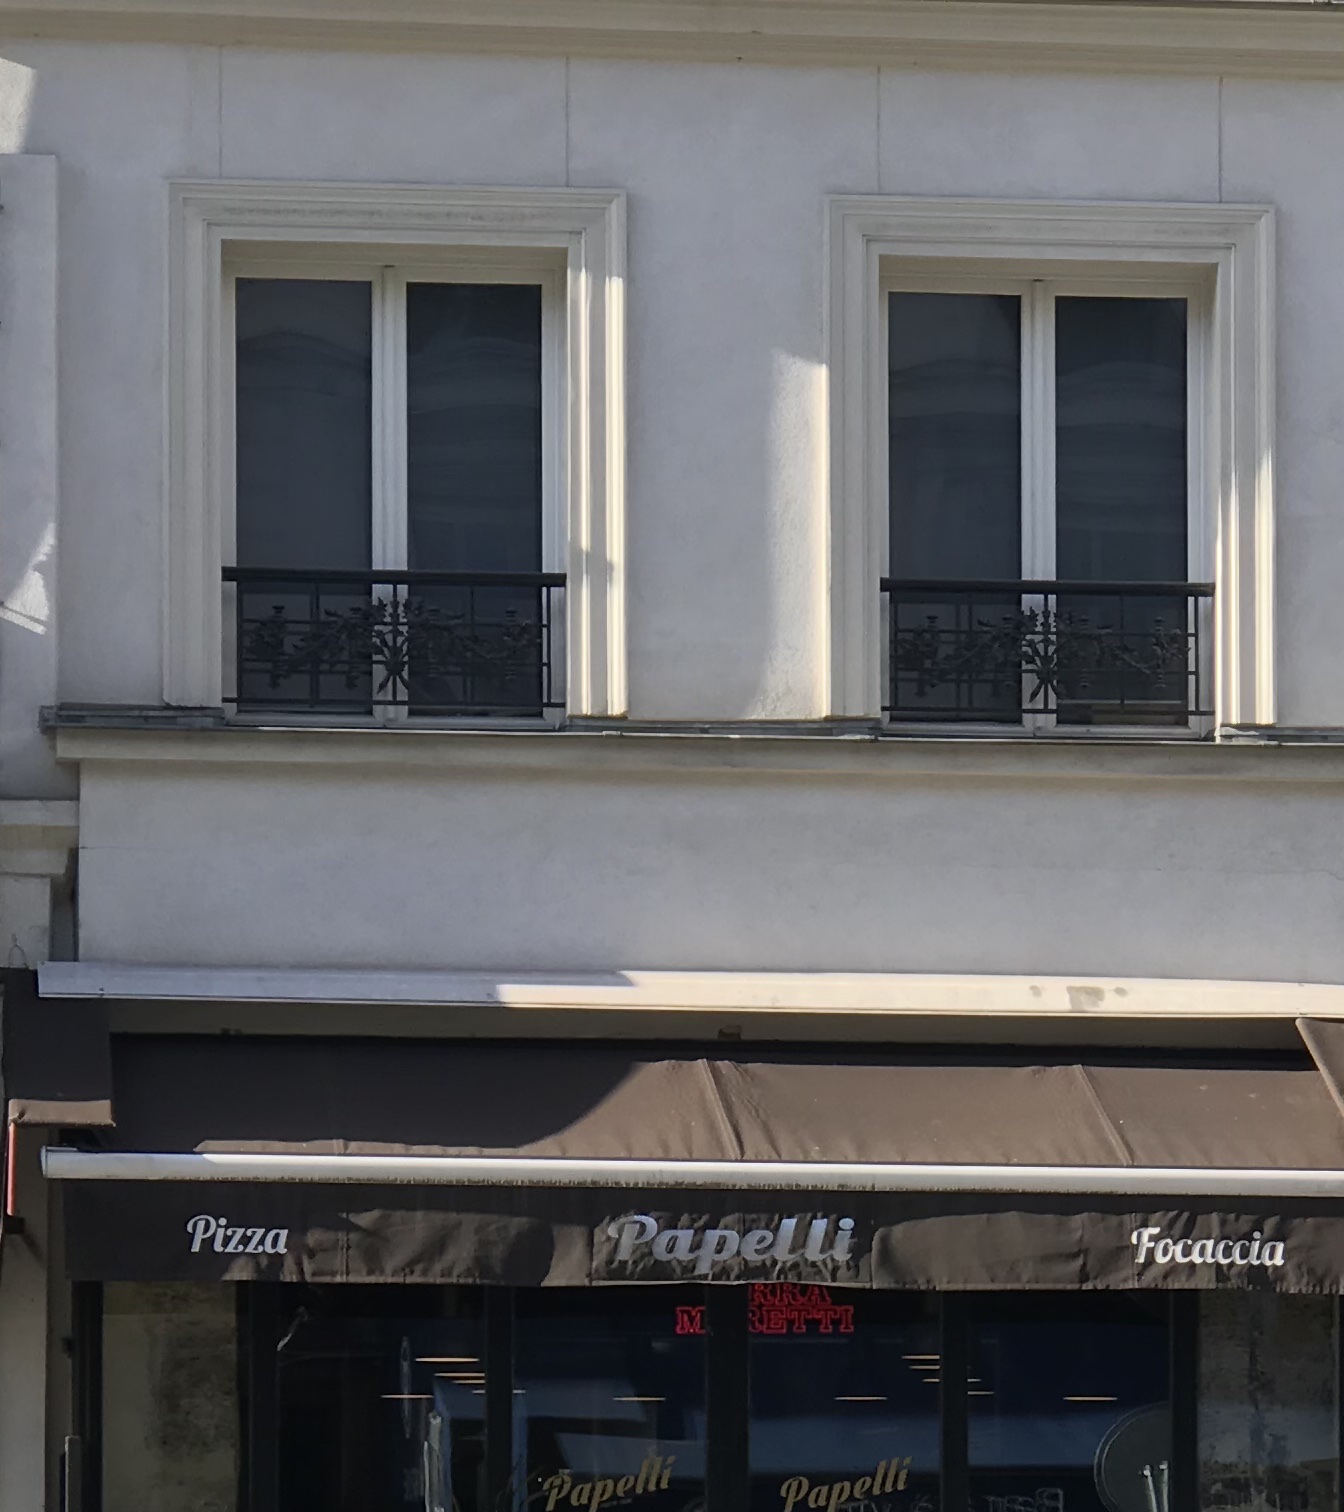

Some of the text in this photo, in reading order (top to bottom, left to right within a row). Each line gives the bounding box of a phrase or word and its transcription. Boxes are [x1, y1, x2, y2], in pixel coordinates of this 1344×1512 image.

[186, 1213, 289, 1255] Pizza
[607, 1212, 857, 1275] Papelli
[1131, 1226, 1285, 1266] Focaccia
